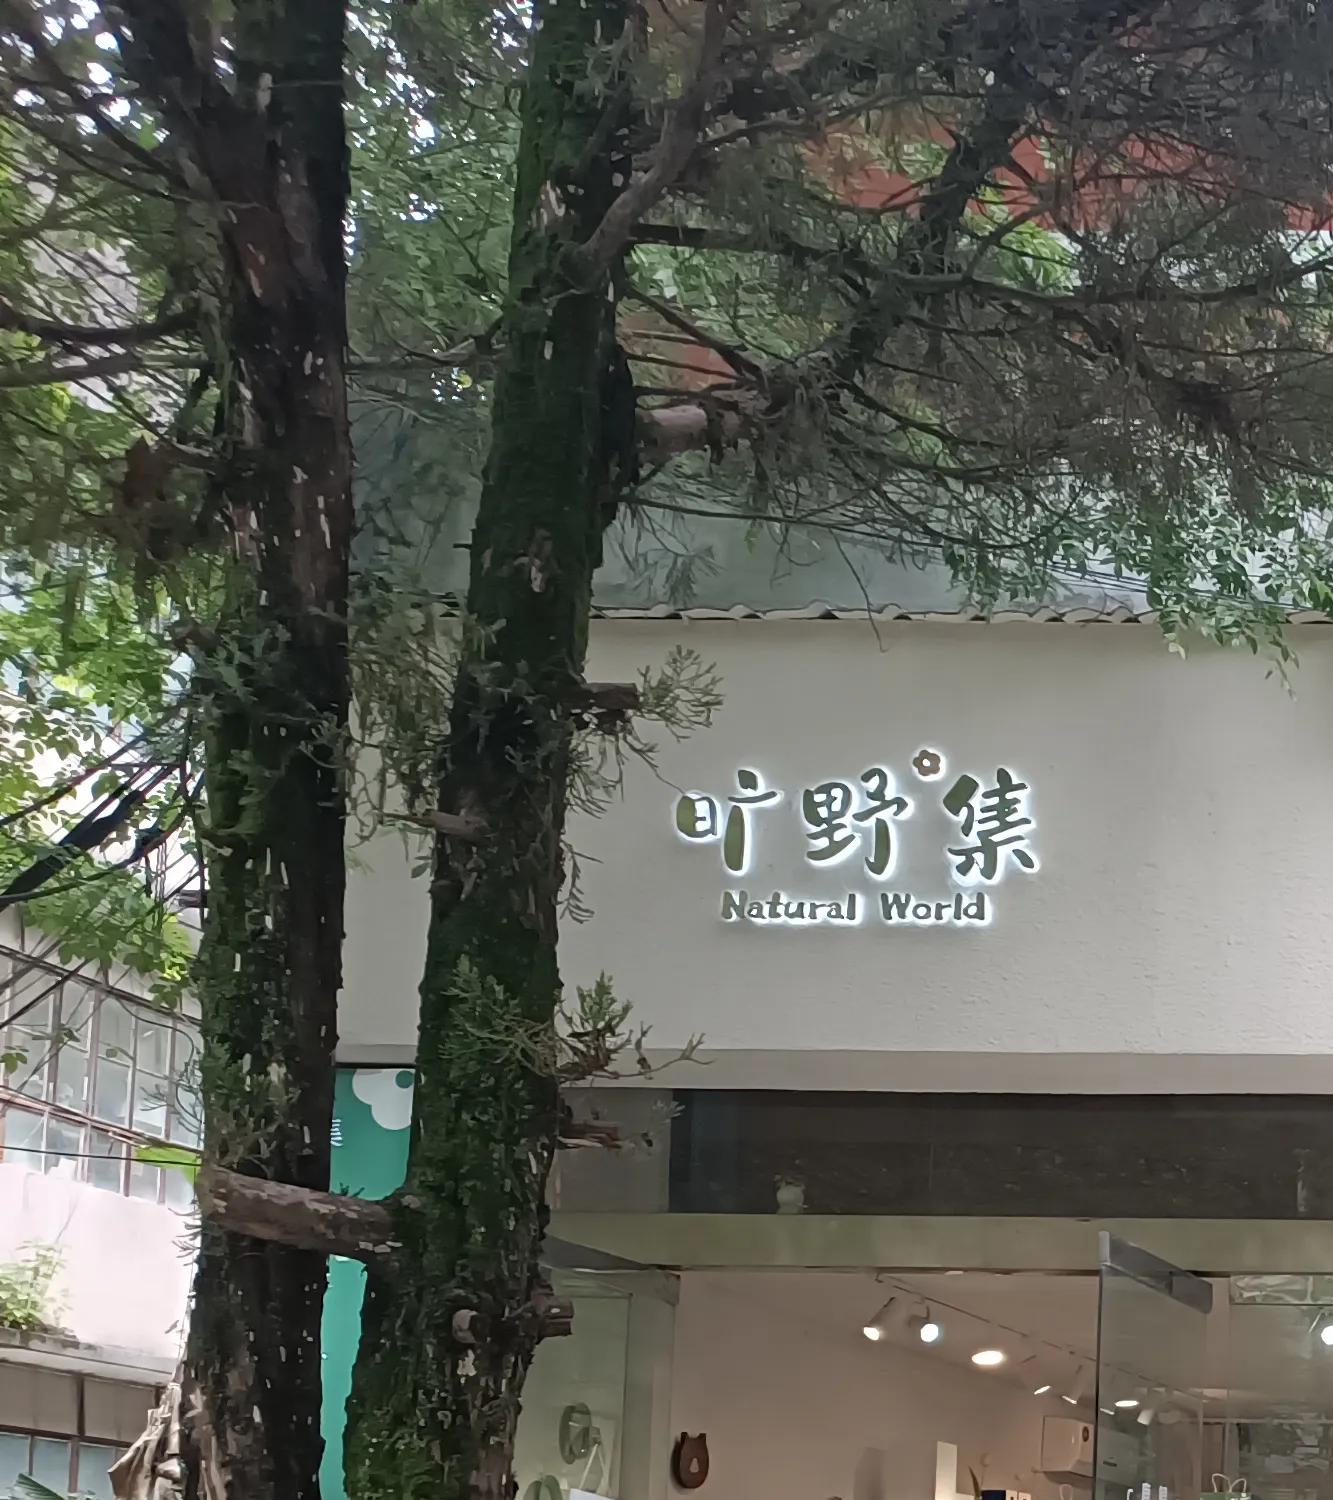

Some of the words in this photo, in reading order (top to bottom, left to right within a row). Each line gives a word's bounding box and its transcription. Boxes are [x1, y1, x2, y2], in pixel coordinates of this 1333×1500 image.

[676, 766, 1040, 882] 旷野集
[721, 890, 858, 921] Natural
[879, 892, 987, 922] World
